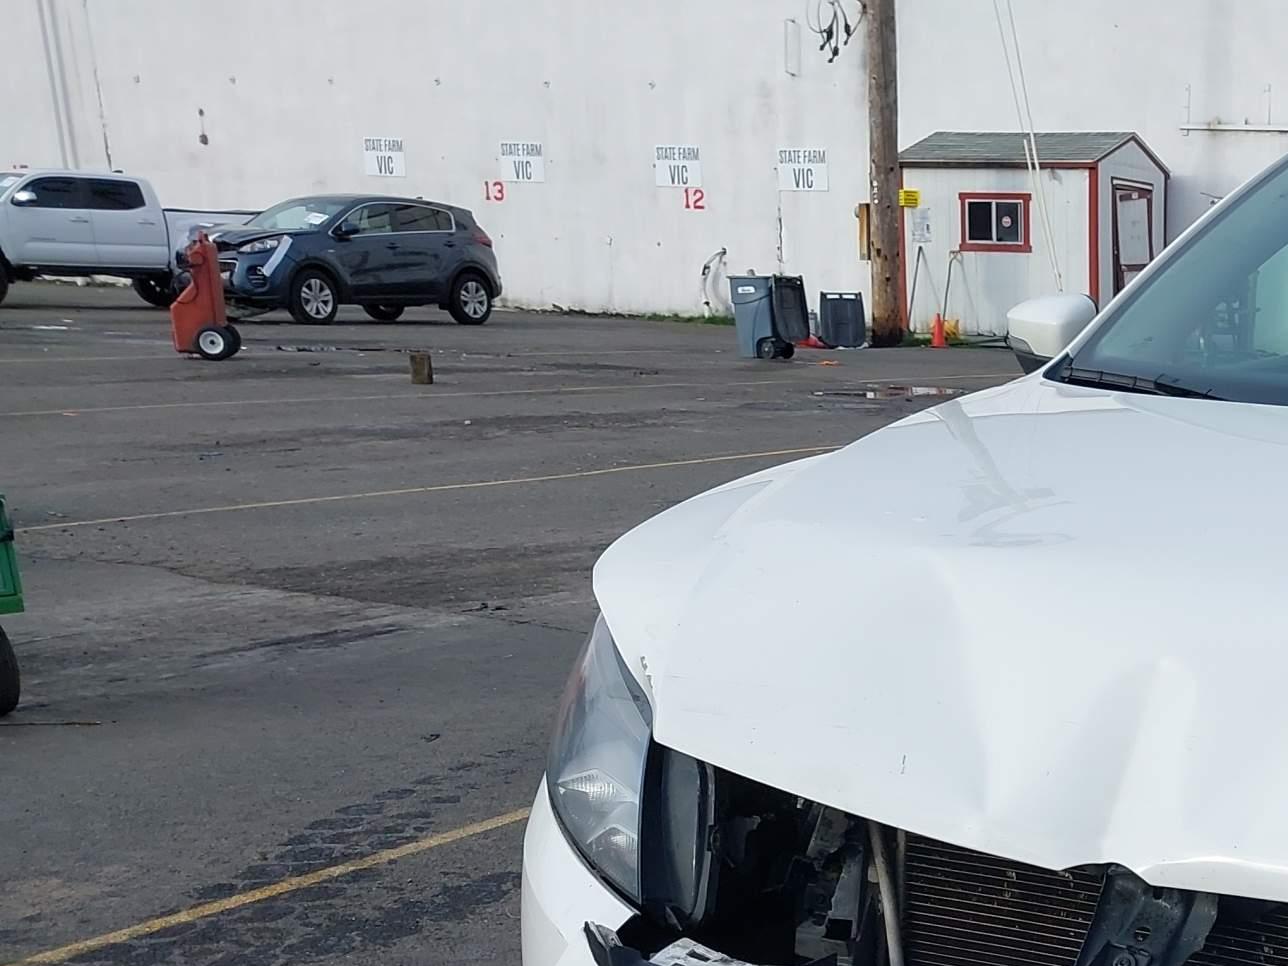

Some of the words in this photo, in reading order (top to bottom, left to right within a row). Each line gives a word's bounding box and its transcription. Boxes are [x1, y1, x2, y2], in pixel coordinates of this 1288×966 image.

[365, 139, 382, 152] STATE
[385, 140, 403, 152] FARM
[501, 143, 520, 156] STATE
[522, 144, 543, 157] FARM
[656, 147, 676, 161] STATE
[678, 148, 699, 161] FARM
[376, 155, 394, 175] VIC
[779, 150, 801, 164] STATE
[803, 151, 826, 164] FARM
[513, 160, 532, 180] VIC
[669, 165, 688, 185] VIC
[793, 168, 813, 189] VIC
[484, 181, 505, 201] 13
[684, 188, 705, 210] 12
